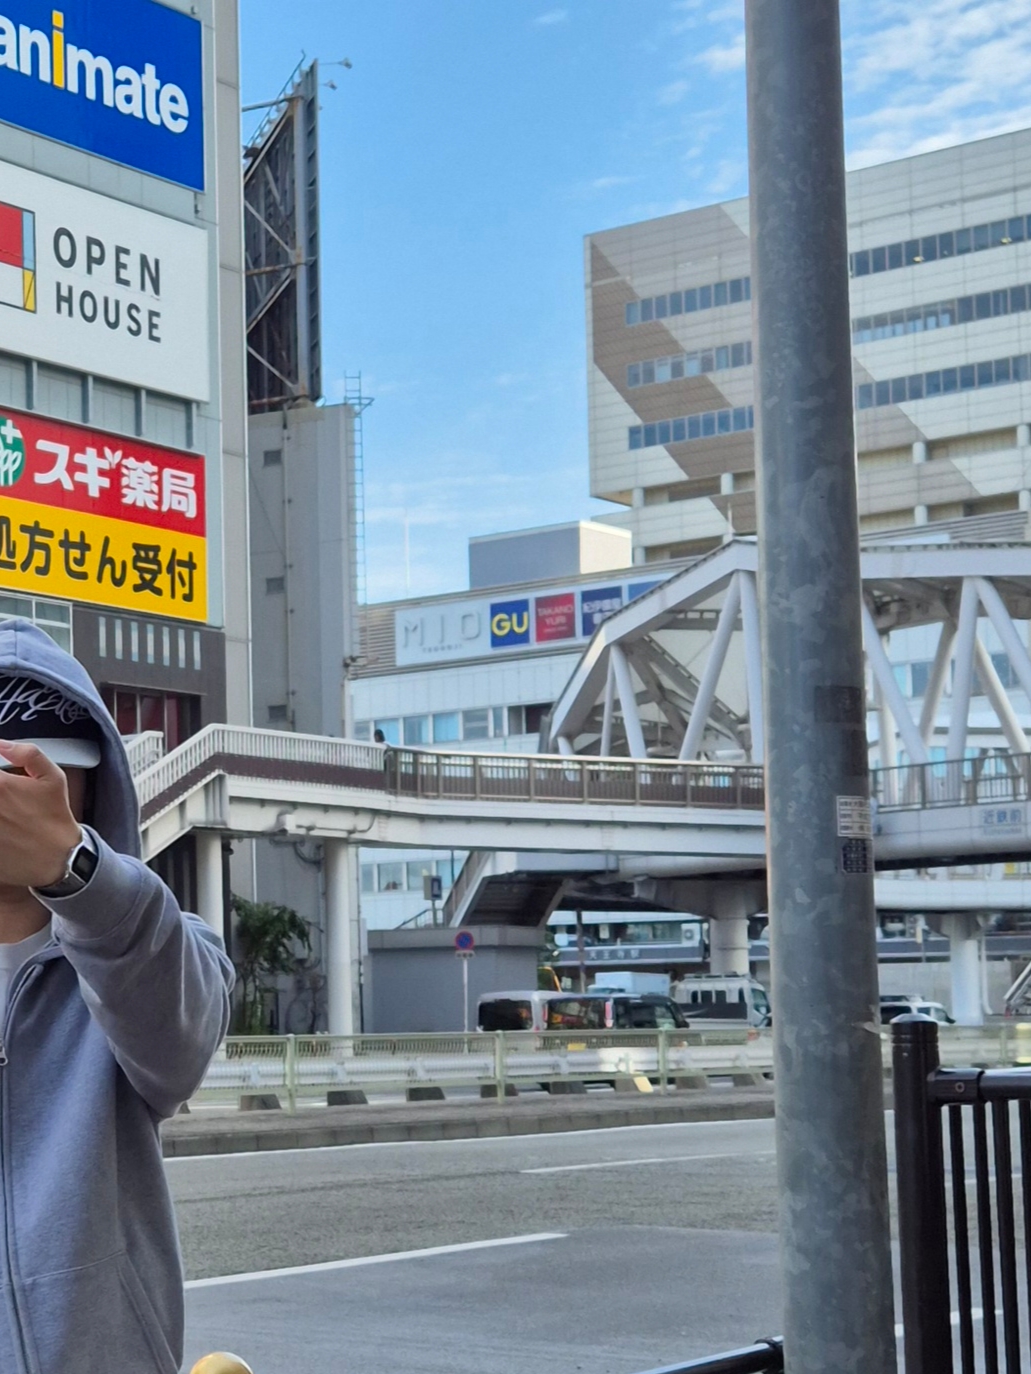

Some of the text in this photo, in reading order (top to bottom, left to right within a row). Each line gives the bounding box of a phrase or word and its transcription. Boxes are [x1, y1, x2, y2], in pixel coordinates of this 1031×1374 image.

[53, 227, 161, 296] OPEN
[55, 281, 162, 344] HOUSE
[34, 438, 198, 519] スギ薬局
[491, 611, 528, 636] GU
